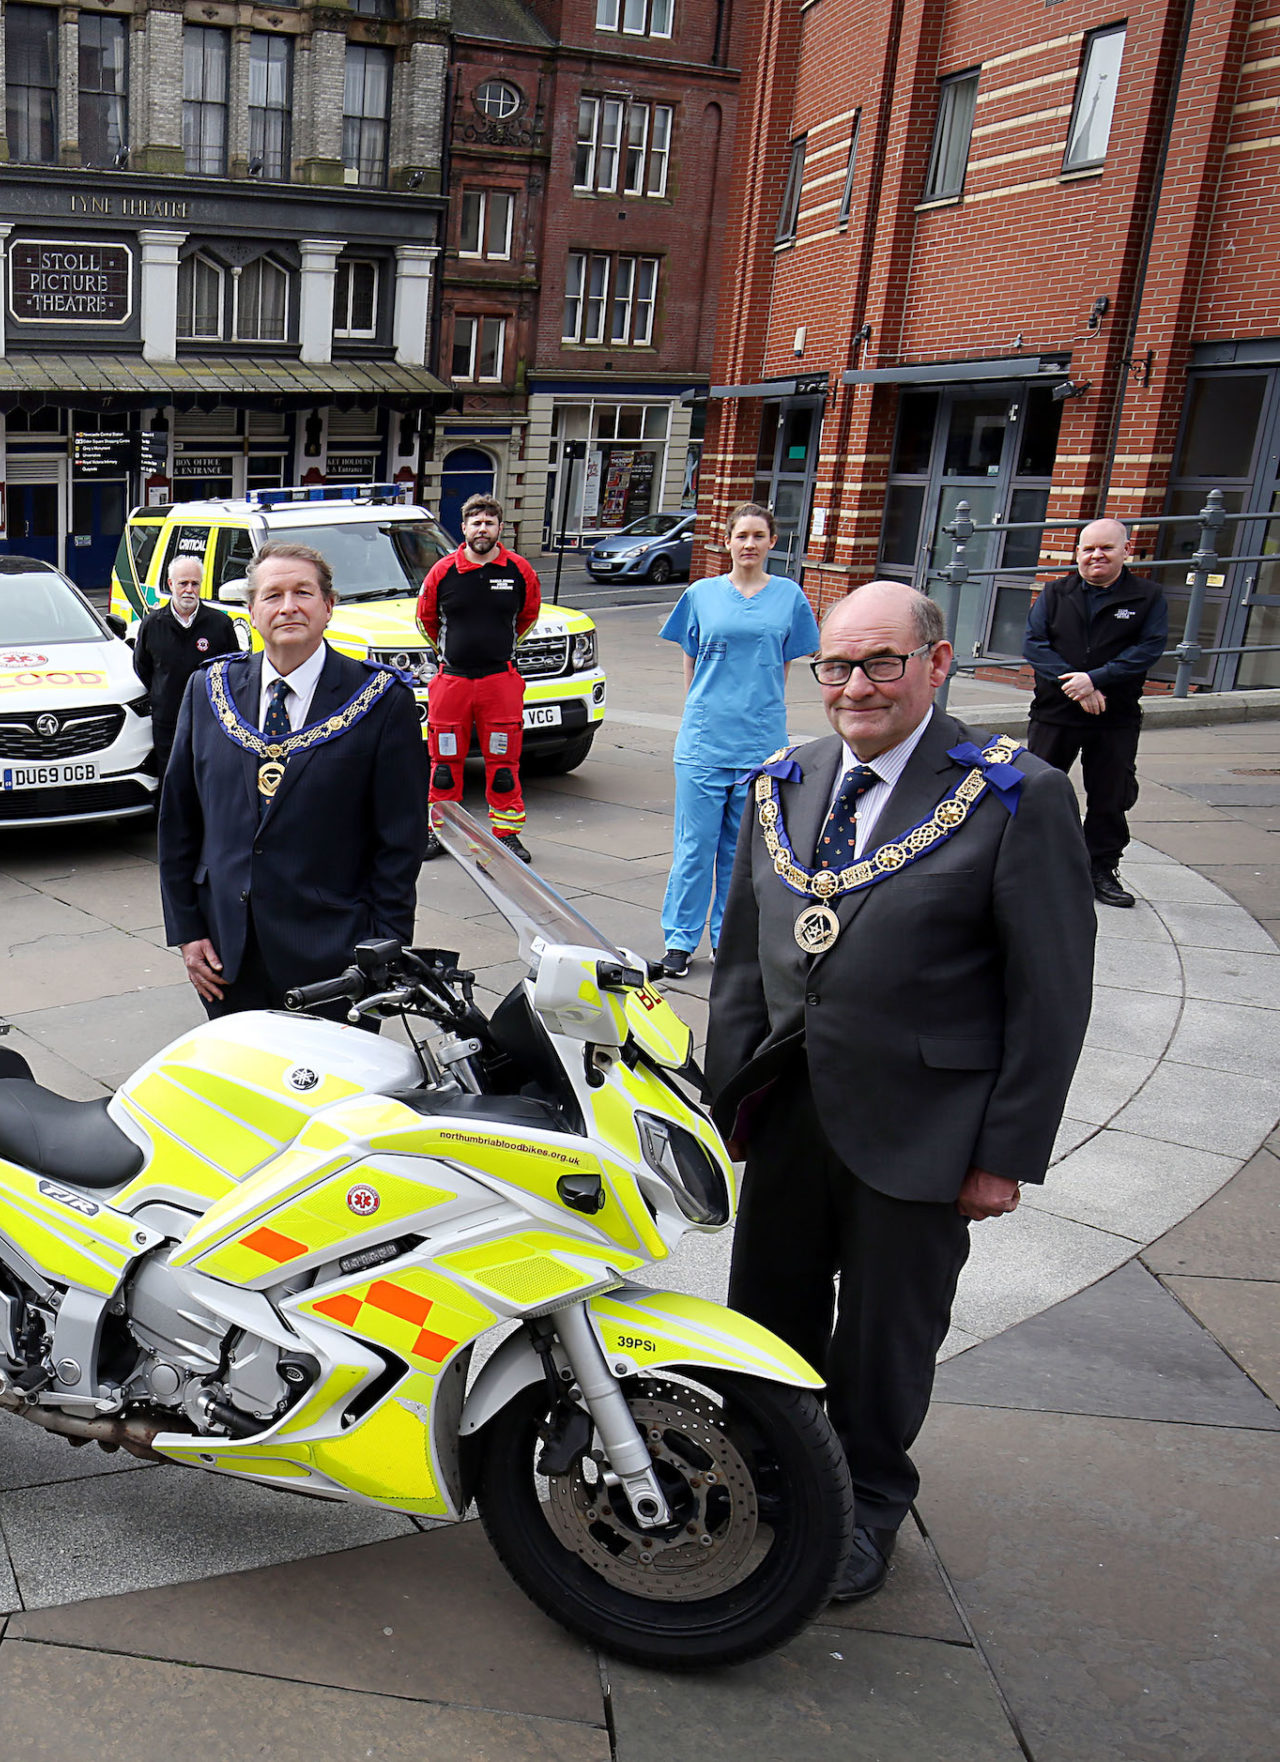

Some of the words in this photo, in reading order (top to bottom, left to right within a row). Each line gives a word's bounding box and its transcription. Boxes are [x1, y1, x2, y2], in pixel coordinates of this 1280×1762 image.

[70, 196, 112, 214] TYNE
[121, 199, 190, 218] THEATRE
[41, 253, 101, 270] STOLL
[30, 274, 108, 291] PICTURE
[32, 295, 106, 313] THEATRE
[176, 458, 191, 466] BOX
[193, 458, 221, 466] OFFICE
[178, 538, 206, 551] CRITICAL
[528, 709, 554, 725] VCG
[15, 767, 58, 786] DU69
[63, 764, 95, 781] OGB
[439, 1131, 580, 1166] northumbriabloodbikes.org.uk
[41, 1183, 96, 1214] FJR
